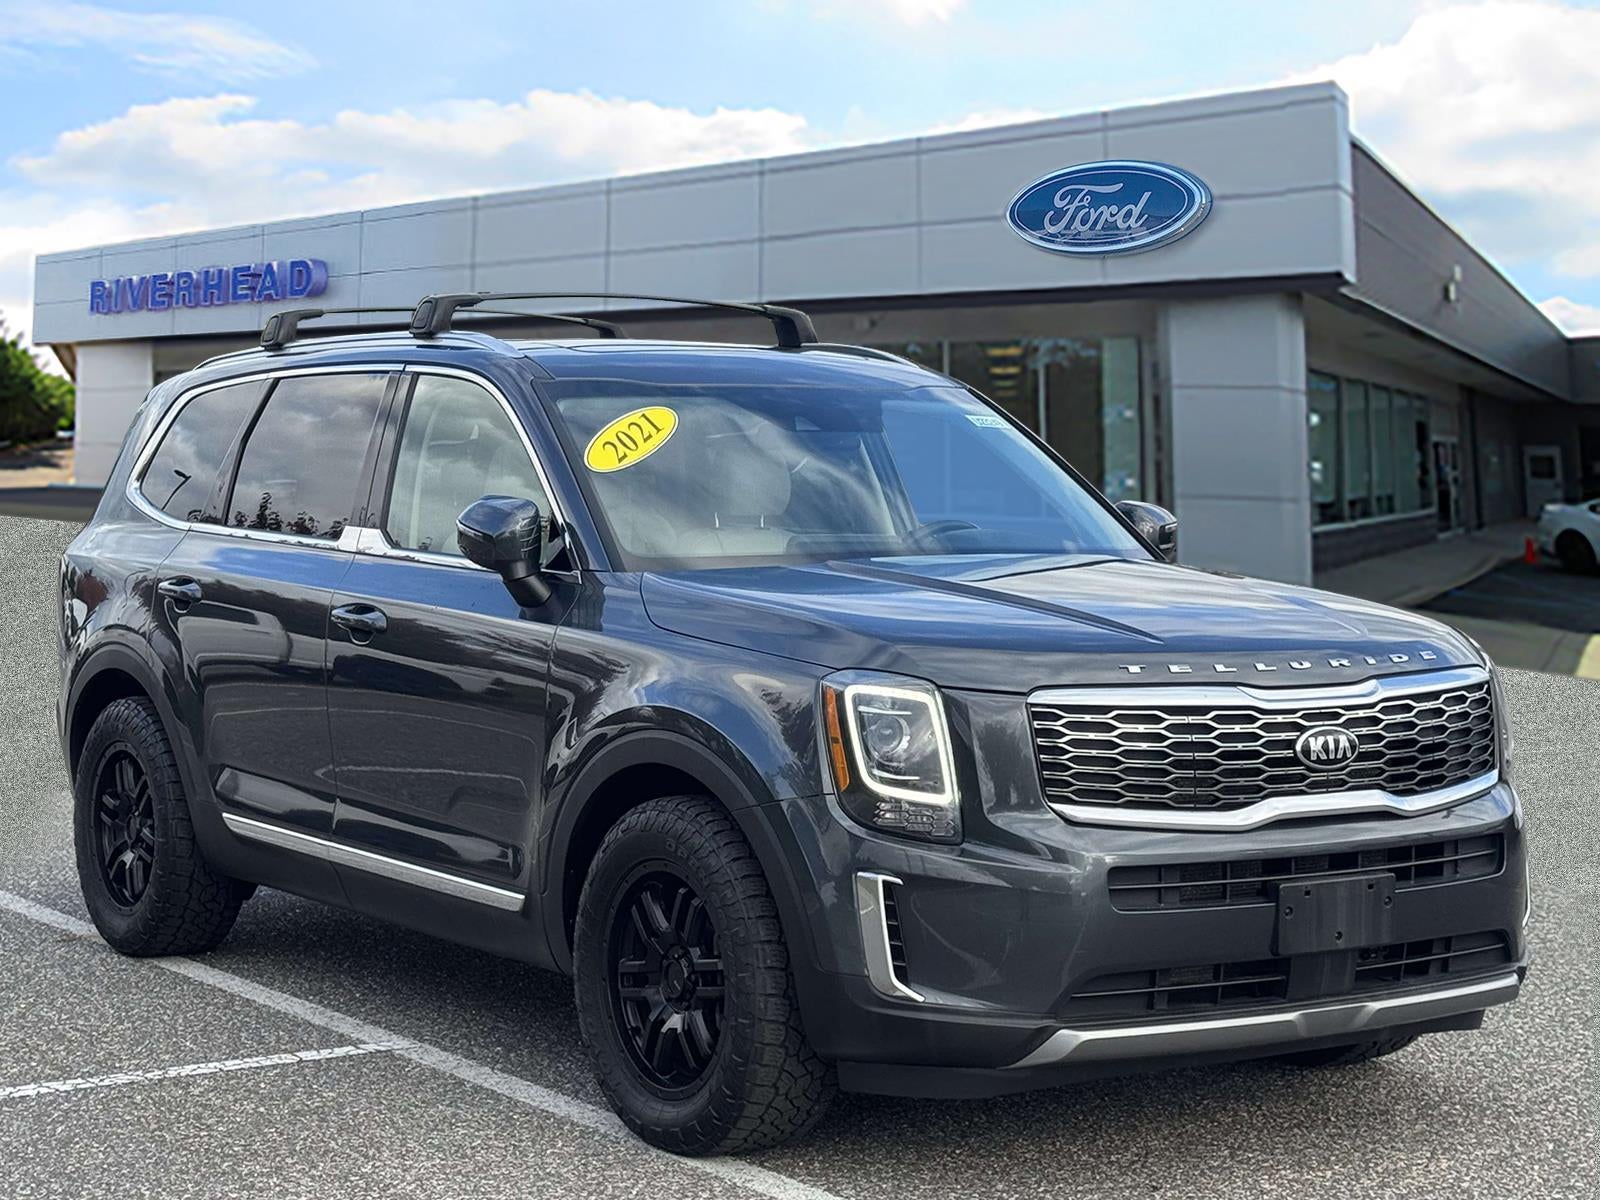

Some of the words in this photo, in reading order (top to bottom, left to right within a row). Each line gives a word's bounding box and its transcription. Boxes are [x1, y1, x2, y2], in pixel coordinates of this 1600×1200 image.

[1044, 182, 1152, 234] Ford
[90, 259, 324, 314] RIVERHEAD
[602, 413, 664, 464] 2021
[1119, 650, 1437, 673] TELLURIDE
[1309, 735, 1351, 761] KIA
